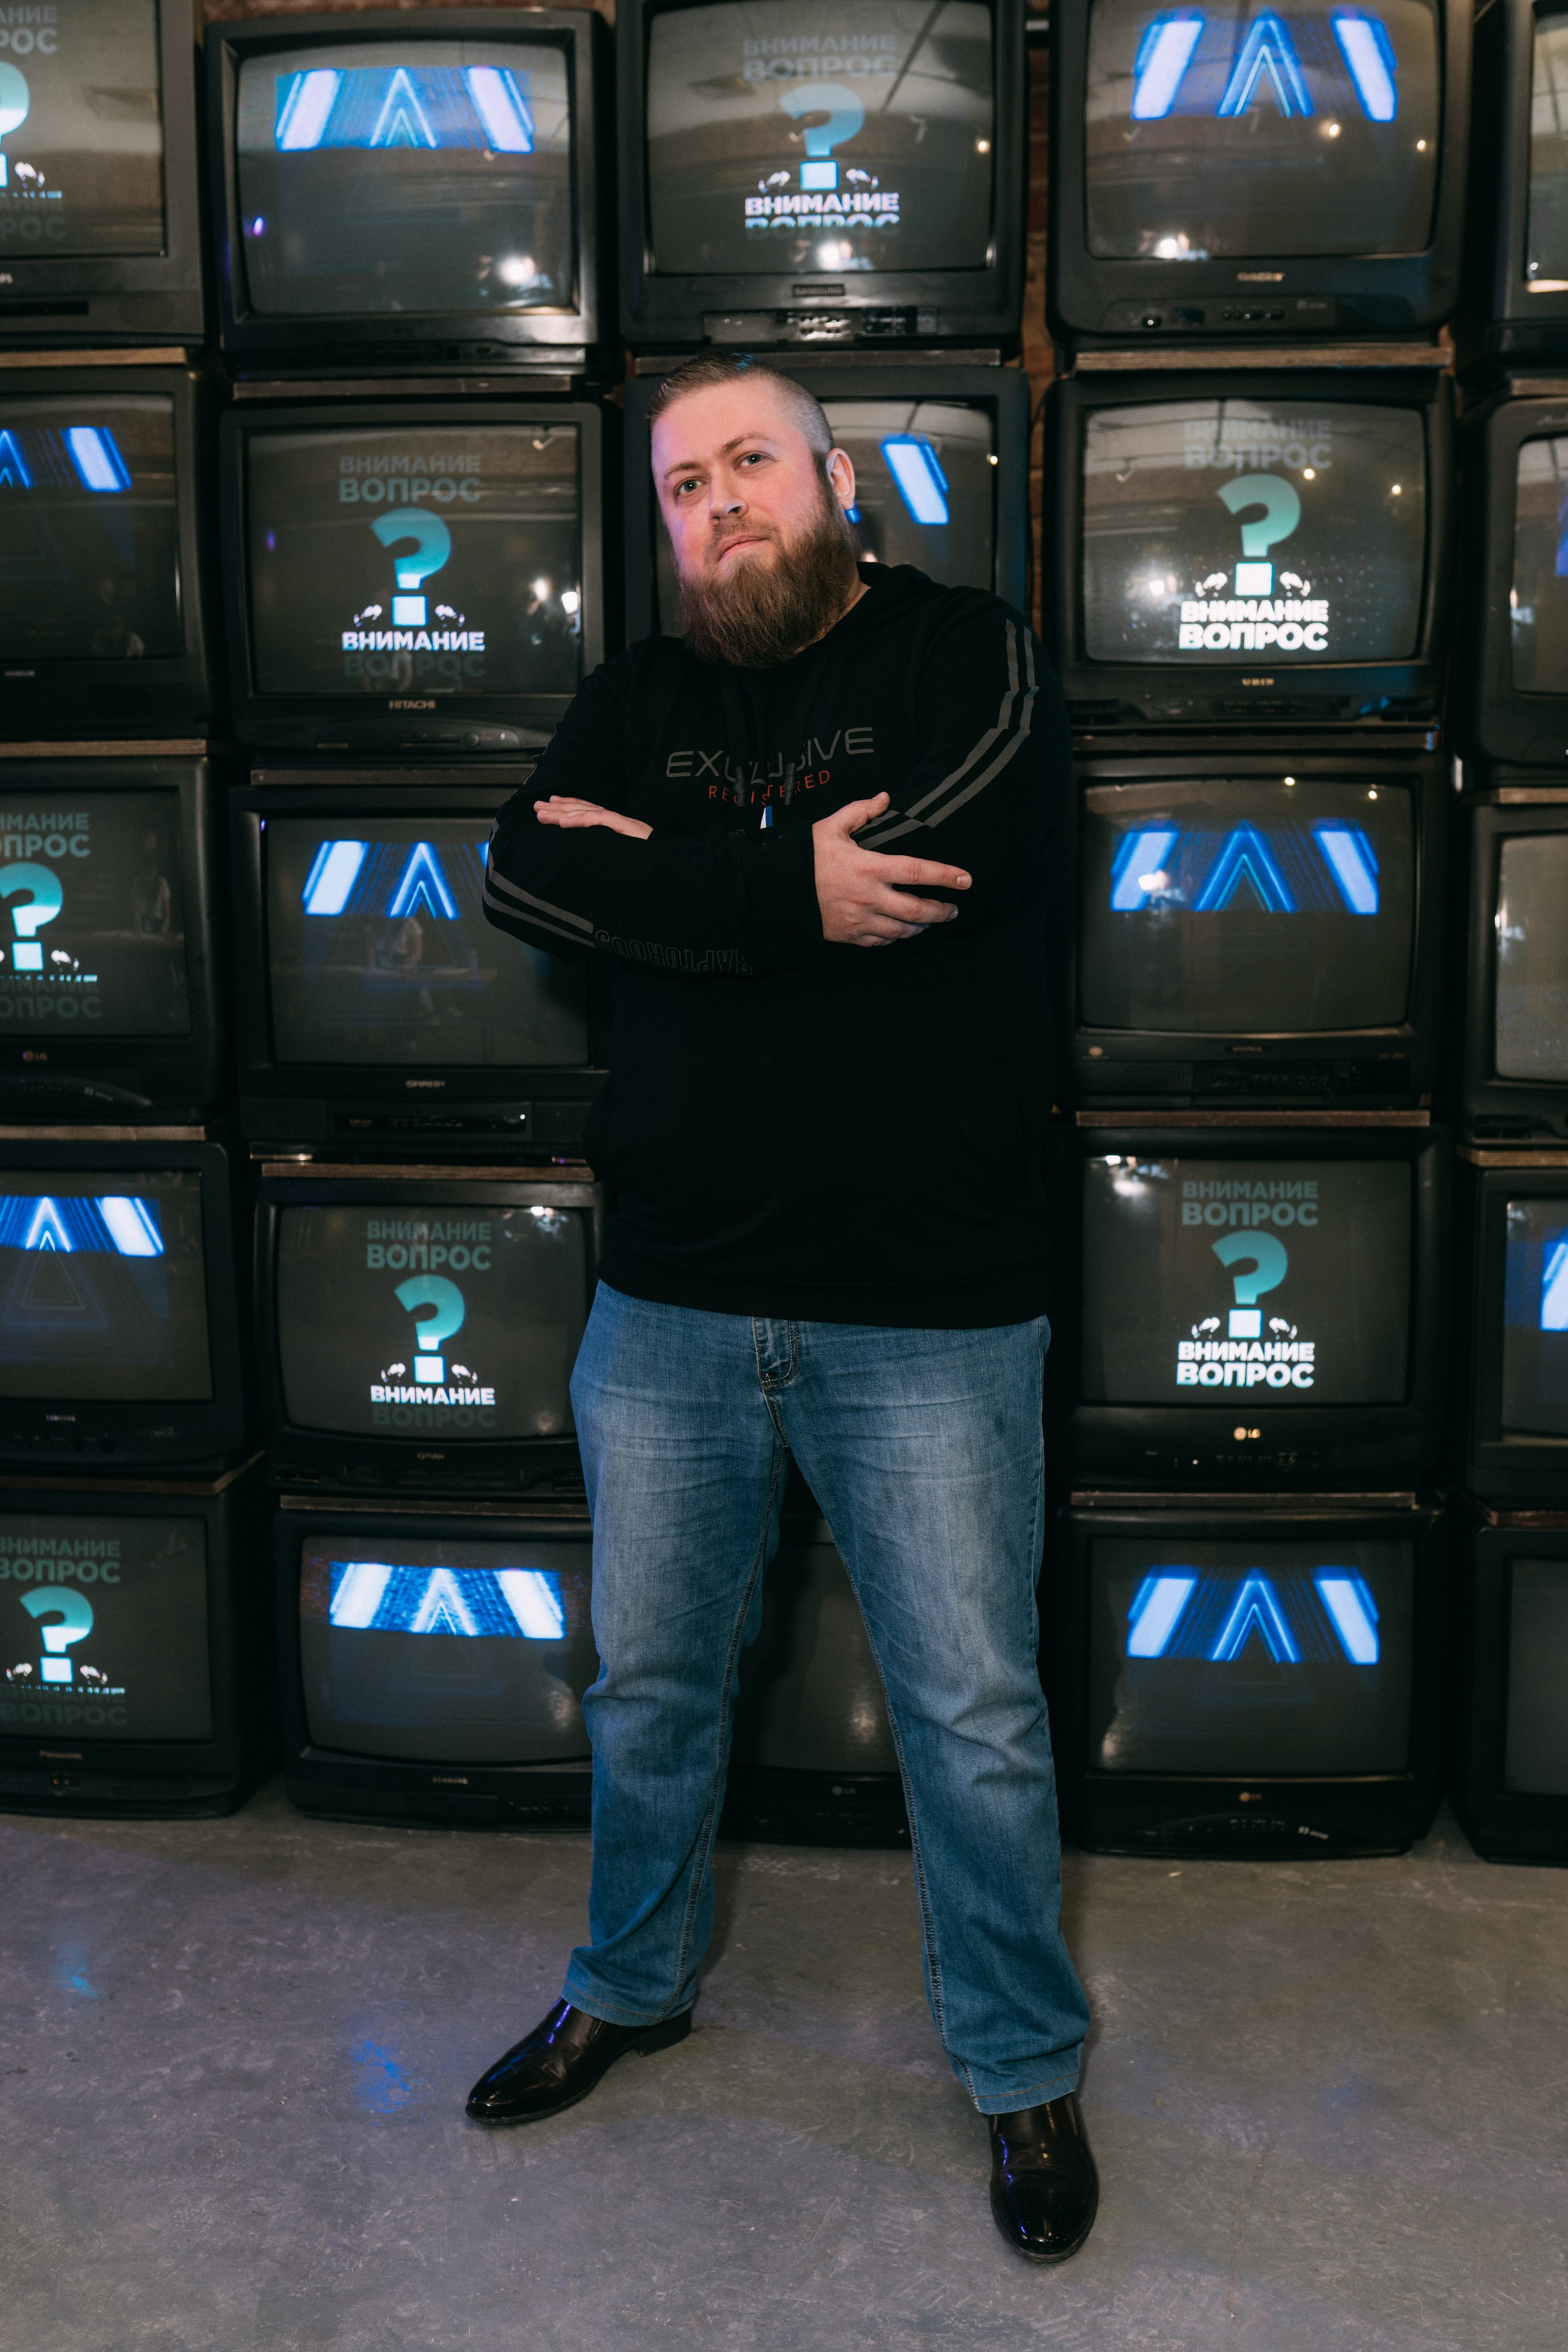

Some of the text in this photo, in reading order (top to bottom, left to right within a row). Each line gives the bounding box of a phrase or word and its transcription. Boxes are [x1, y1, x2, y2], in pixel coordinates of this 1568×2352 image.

[743, 34, 896, 56] ВНИМАНИЕ
[743, 55, 896, 83] ВОПРОС
[745, 192, 900, 216] ВНИМАНИЕ
[1184, 418, 1331, 440] ВНИМАНИЕ
[339, 455, 481, 473] ВНИМАНИЕ
[1184, 443, 1332, 469] ВОПРОС
[339, 478, 483, 503] ВОПРОС
[1180, 600, 1329, 623] ВНИМАНИЕ
[341, 631, 485, 651] ВНИМАНИЕ
[1178, 623, 1329, 650] ВОПРОС
[389, 700, 435, 709] HITACHI
[0, 813, 90, 831] МАНИЕ
[0, 834, 90, 858] ПРОС
[594, 929, 753, 976] RAPTUROUS
[1183, 1182, 1317, 1199] ВНИМАНИЕ
[1182, 1202, 1318, 1226] ВОПРОС
[368, 1221, 491, 1241] ВНИМАНИЕ
[368, 1244, 491, 1270] ВОПРОС
[1178, 1341, 1314, 1362] ВНИМАНИЕ
[1176, 1362, 1314, 1389] ВОПРОС
[371, 1385, 495, 1405] ВНИМАНИЕ
[0, 1538, 121, 1558] НИМАНИЕ
